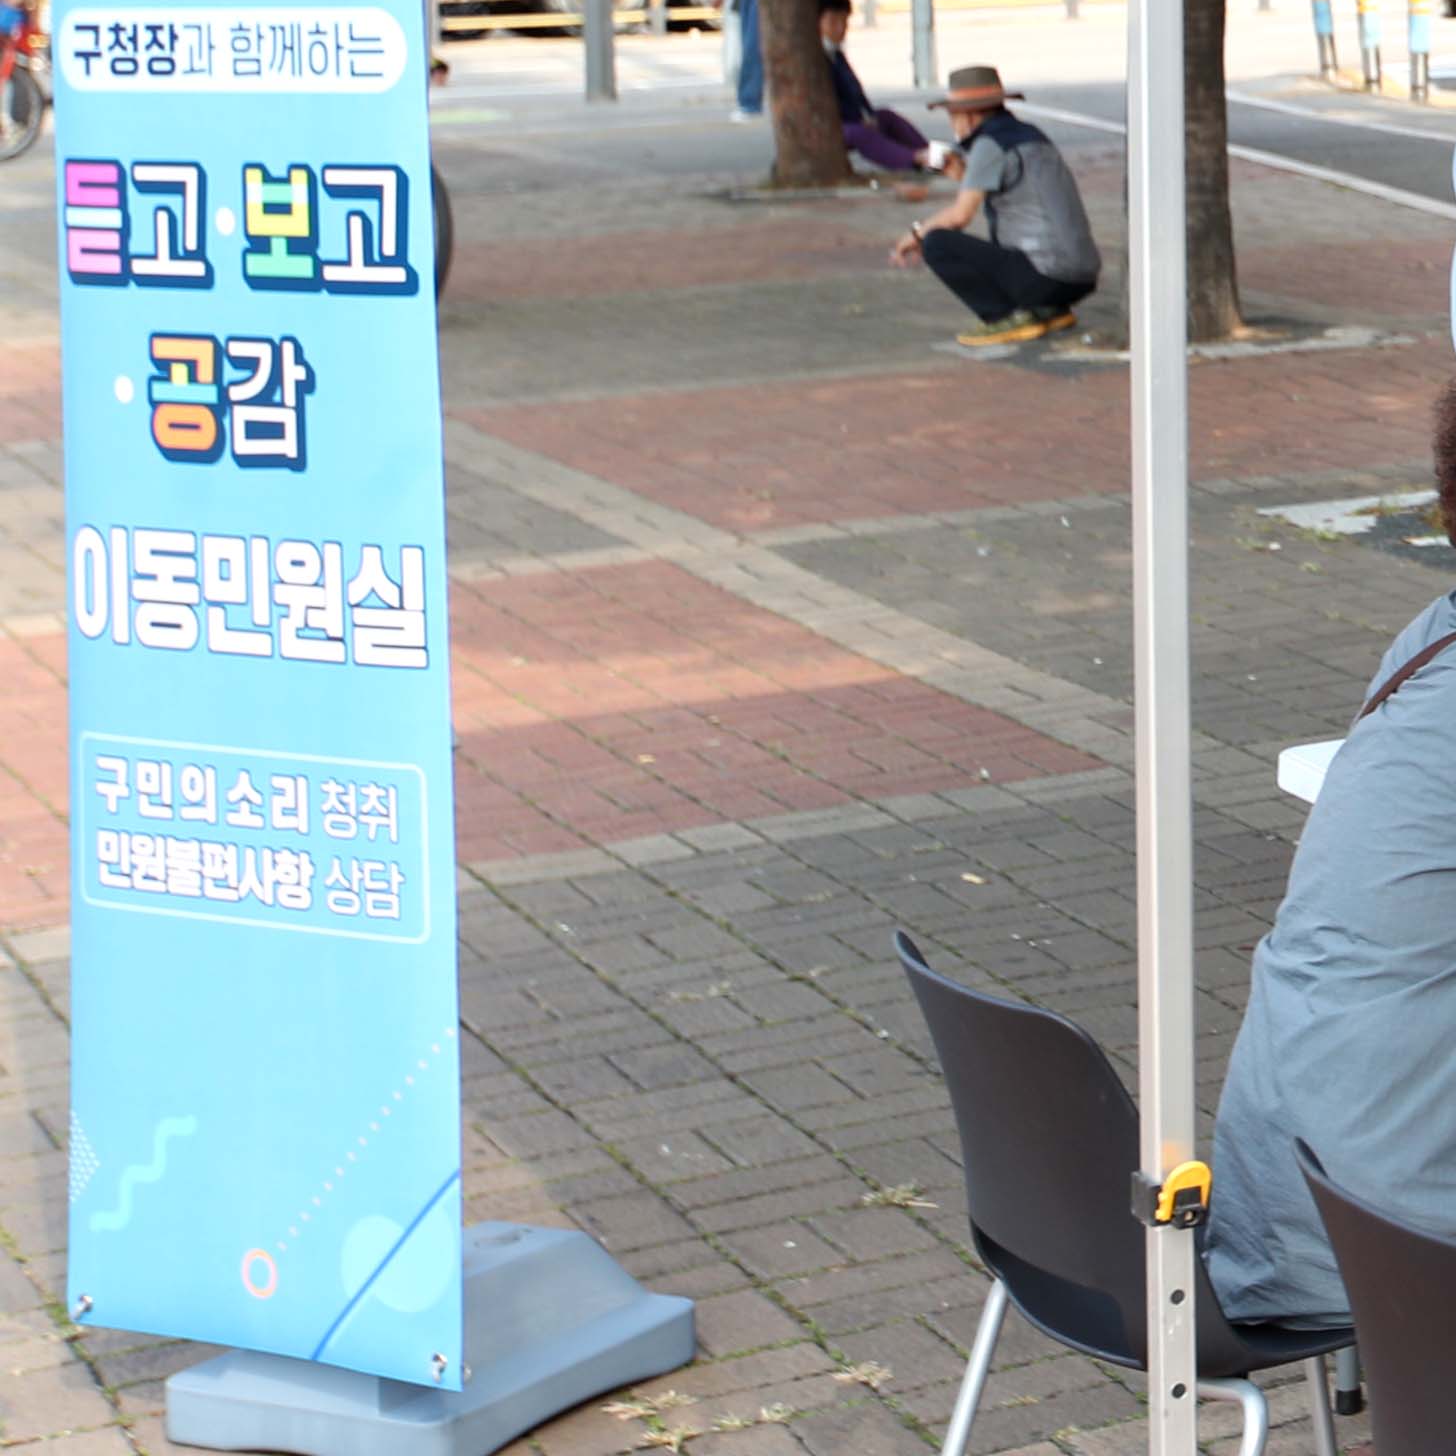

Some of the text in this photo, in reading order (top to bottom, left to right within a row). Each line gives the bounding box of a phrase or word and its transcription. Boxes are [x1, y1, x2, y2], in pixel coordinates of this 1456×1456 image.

[73, 22, 386, 79] 구청장과 함께하는
[72, 523, 431, 670] 이동민원실
[319, 774, 400, 844] 청취
[96, 833, 404, 920] 민원불편사항 상담
